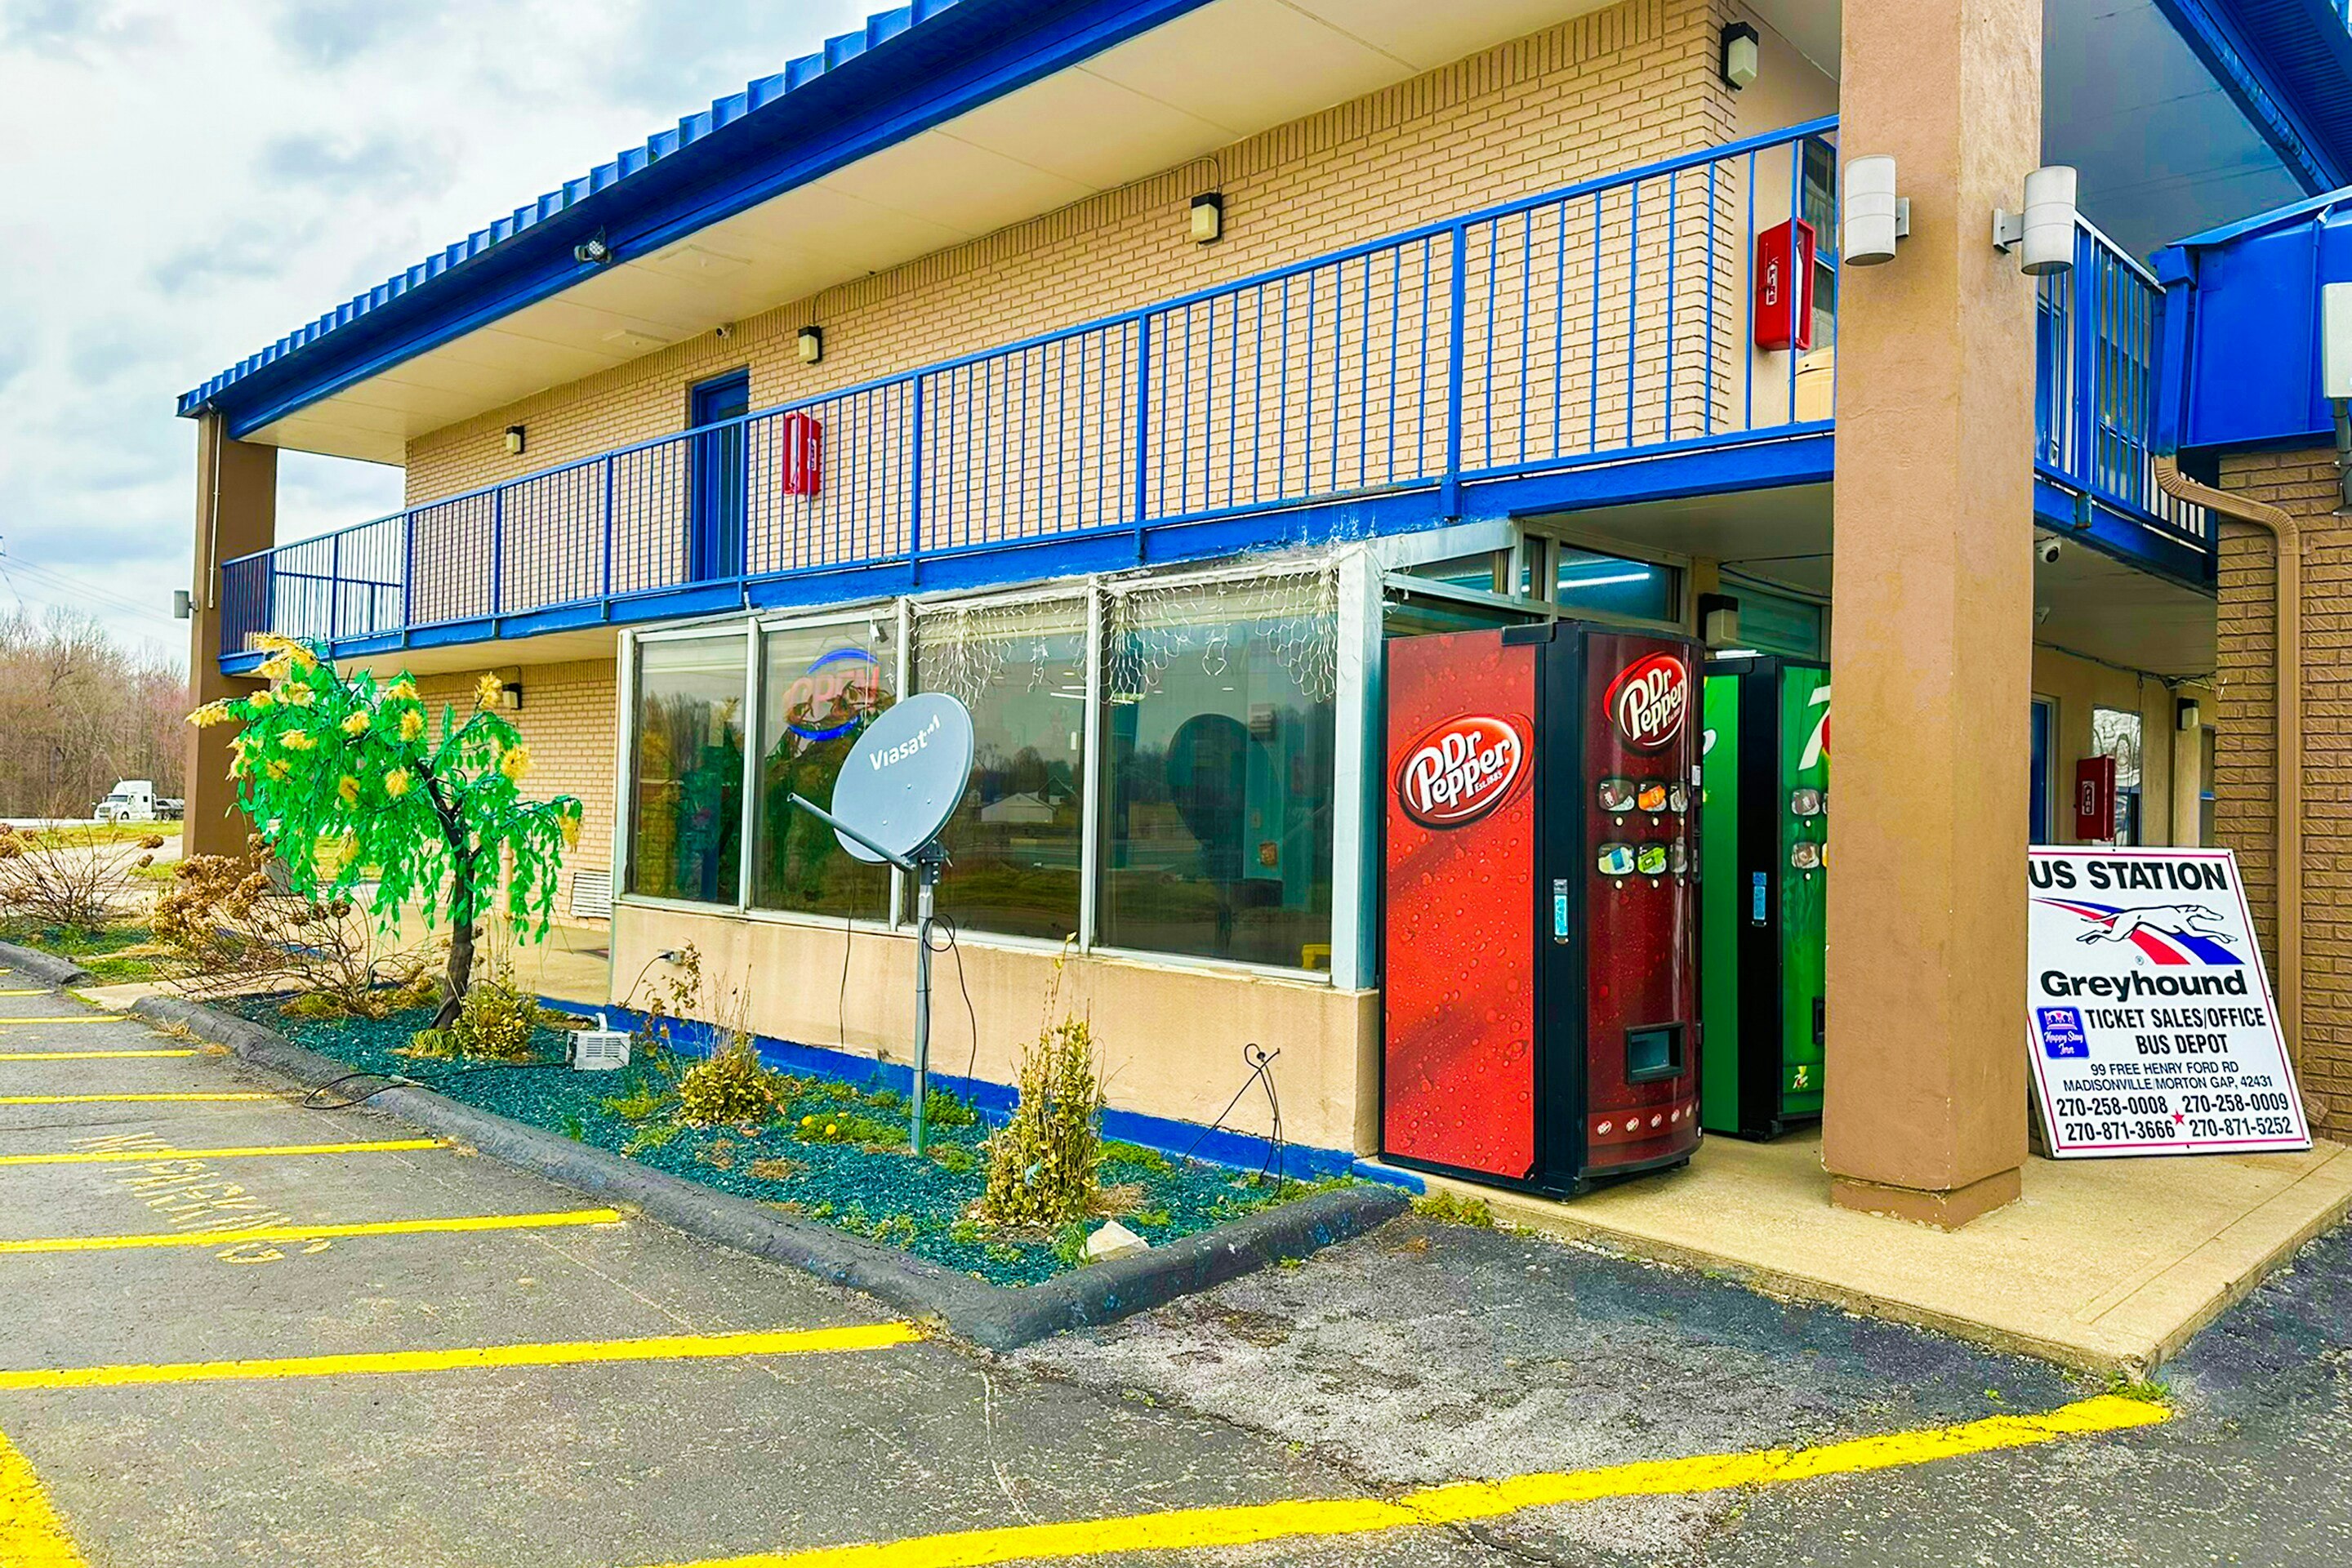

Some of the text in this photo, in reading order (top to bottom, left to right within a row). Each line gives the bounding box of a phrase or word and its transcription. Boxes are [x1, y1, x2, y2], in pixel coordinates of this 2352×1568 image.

[1647, 668, 1672, 705] Dr
[1619, 679, 1684, 741] Pepper
[869, 730, 928, 770] Viasat
[1441, 731, 1482, 772] Dr
[1405, 739, 1510, 813] Pepper
[2029, 860, 2229, 890] US STATION
[2041, 970, 2247, 1002] Greyhound
[2085, 1008, 2266, 1029] TICKET SALES/OFFICE
[2136, 1034, 2230, 1054] BUS DEPOT
[2090, 1061, 2239, 1076] 99 FREE HENRY FORD RD
[2210, 1076, 2238, 1089] GAP,
[2240, 1075, 2273, 1087] 42431
[2056, 1093, 2289, 1116] 270-258-0008 270-258-0009
[2065, 1116, 2294, 1141] 270-871-3666 270-871-5252
